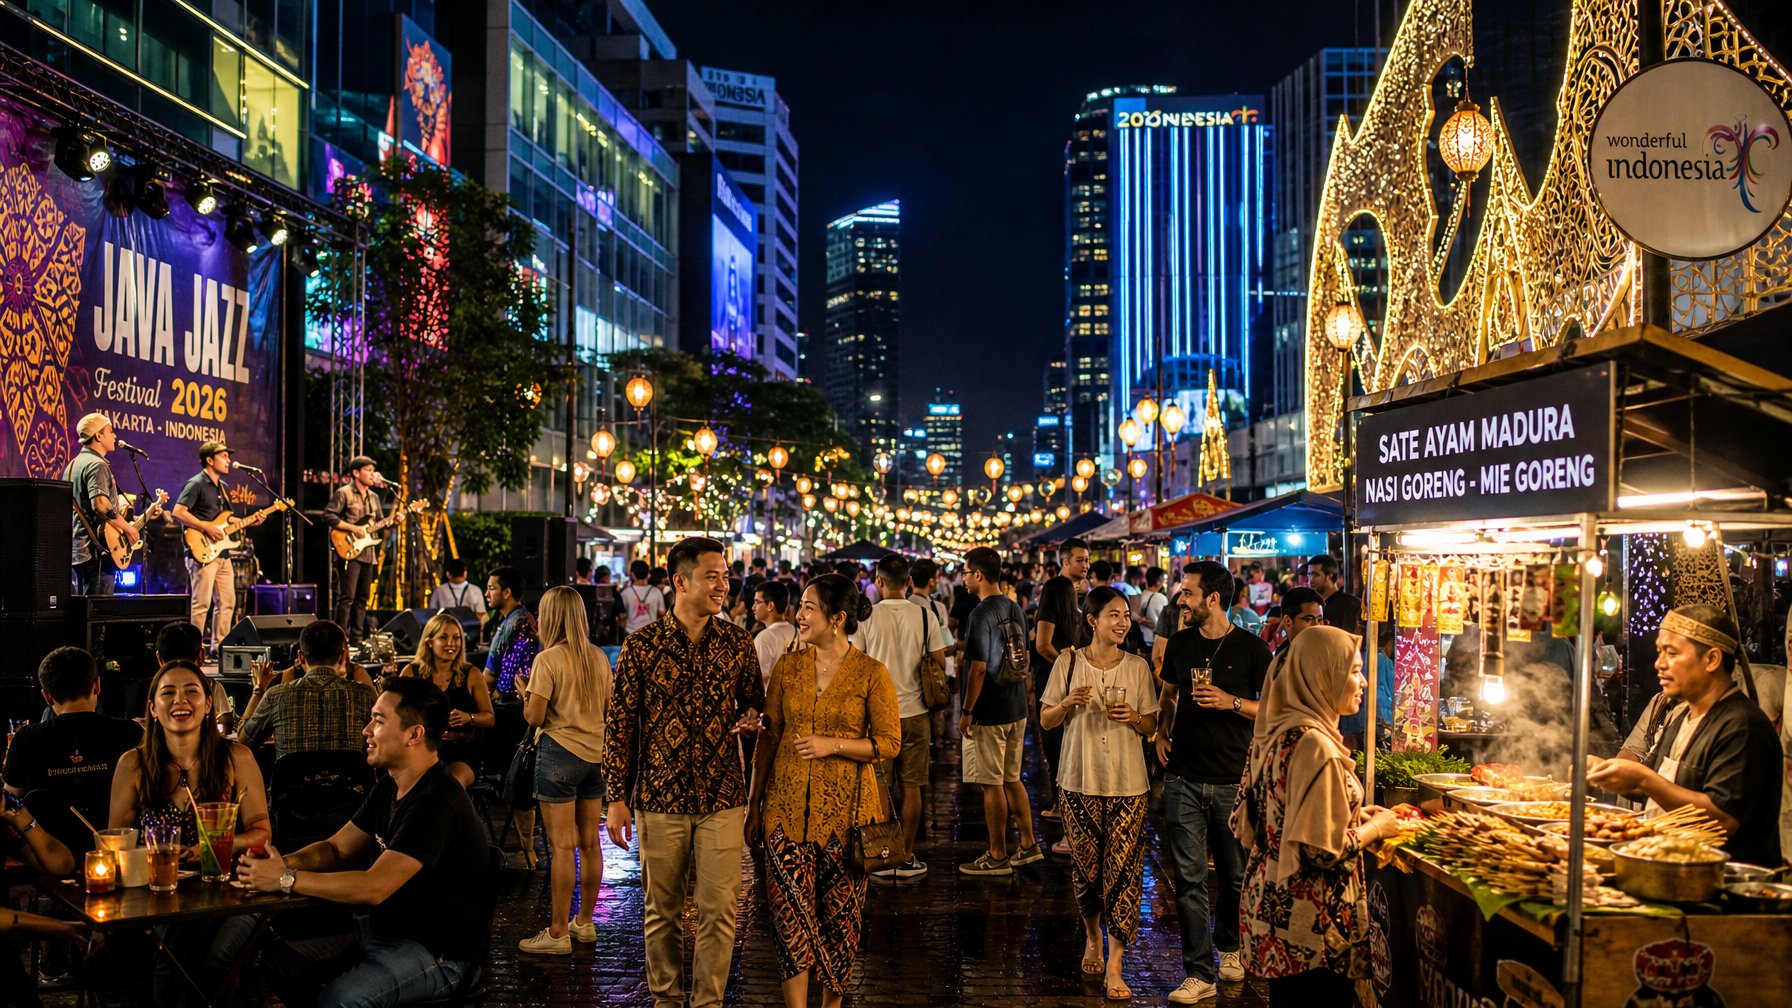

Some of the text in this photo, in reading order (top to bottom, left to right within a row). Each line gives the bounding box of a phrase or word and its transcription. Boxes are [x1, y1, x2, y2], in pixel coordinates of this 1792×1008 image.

[1606, 132, 1687, 149] wonderful
[1606, 151, 1727, 180] indonesia
[94, 241, 250, 384] JAVA JAZZ
[93, 367, 227, 422] Festival 2026
[96, 408, 155, 434] AKARTA
[165, 420, 226, 445] INDONESIA
[1378, 403, 1575, 464] SATE AYAM MADURA
[1365, 476, 1398, 503] NASI
[1402, 468, 1466, 501] GORENG
[1480, 463, 1511, 495] MIE
[1515, 453, 1595, 492] GORENG
